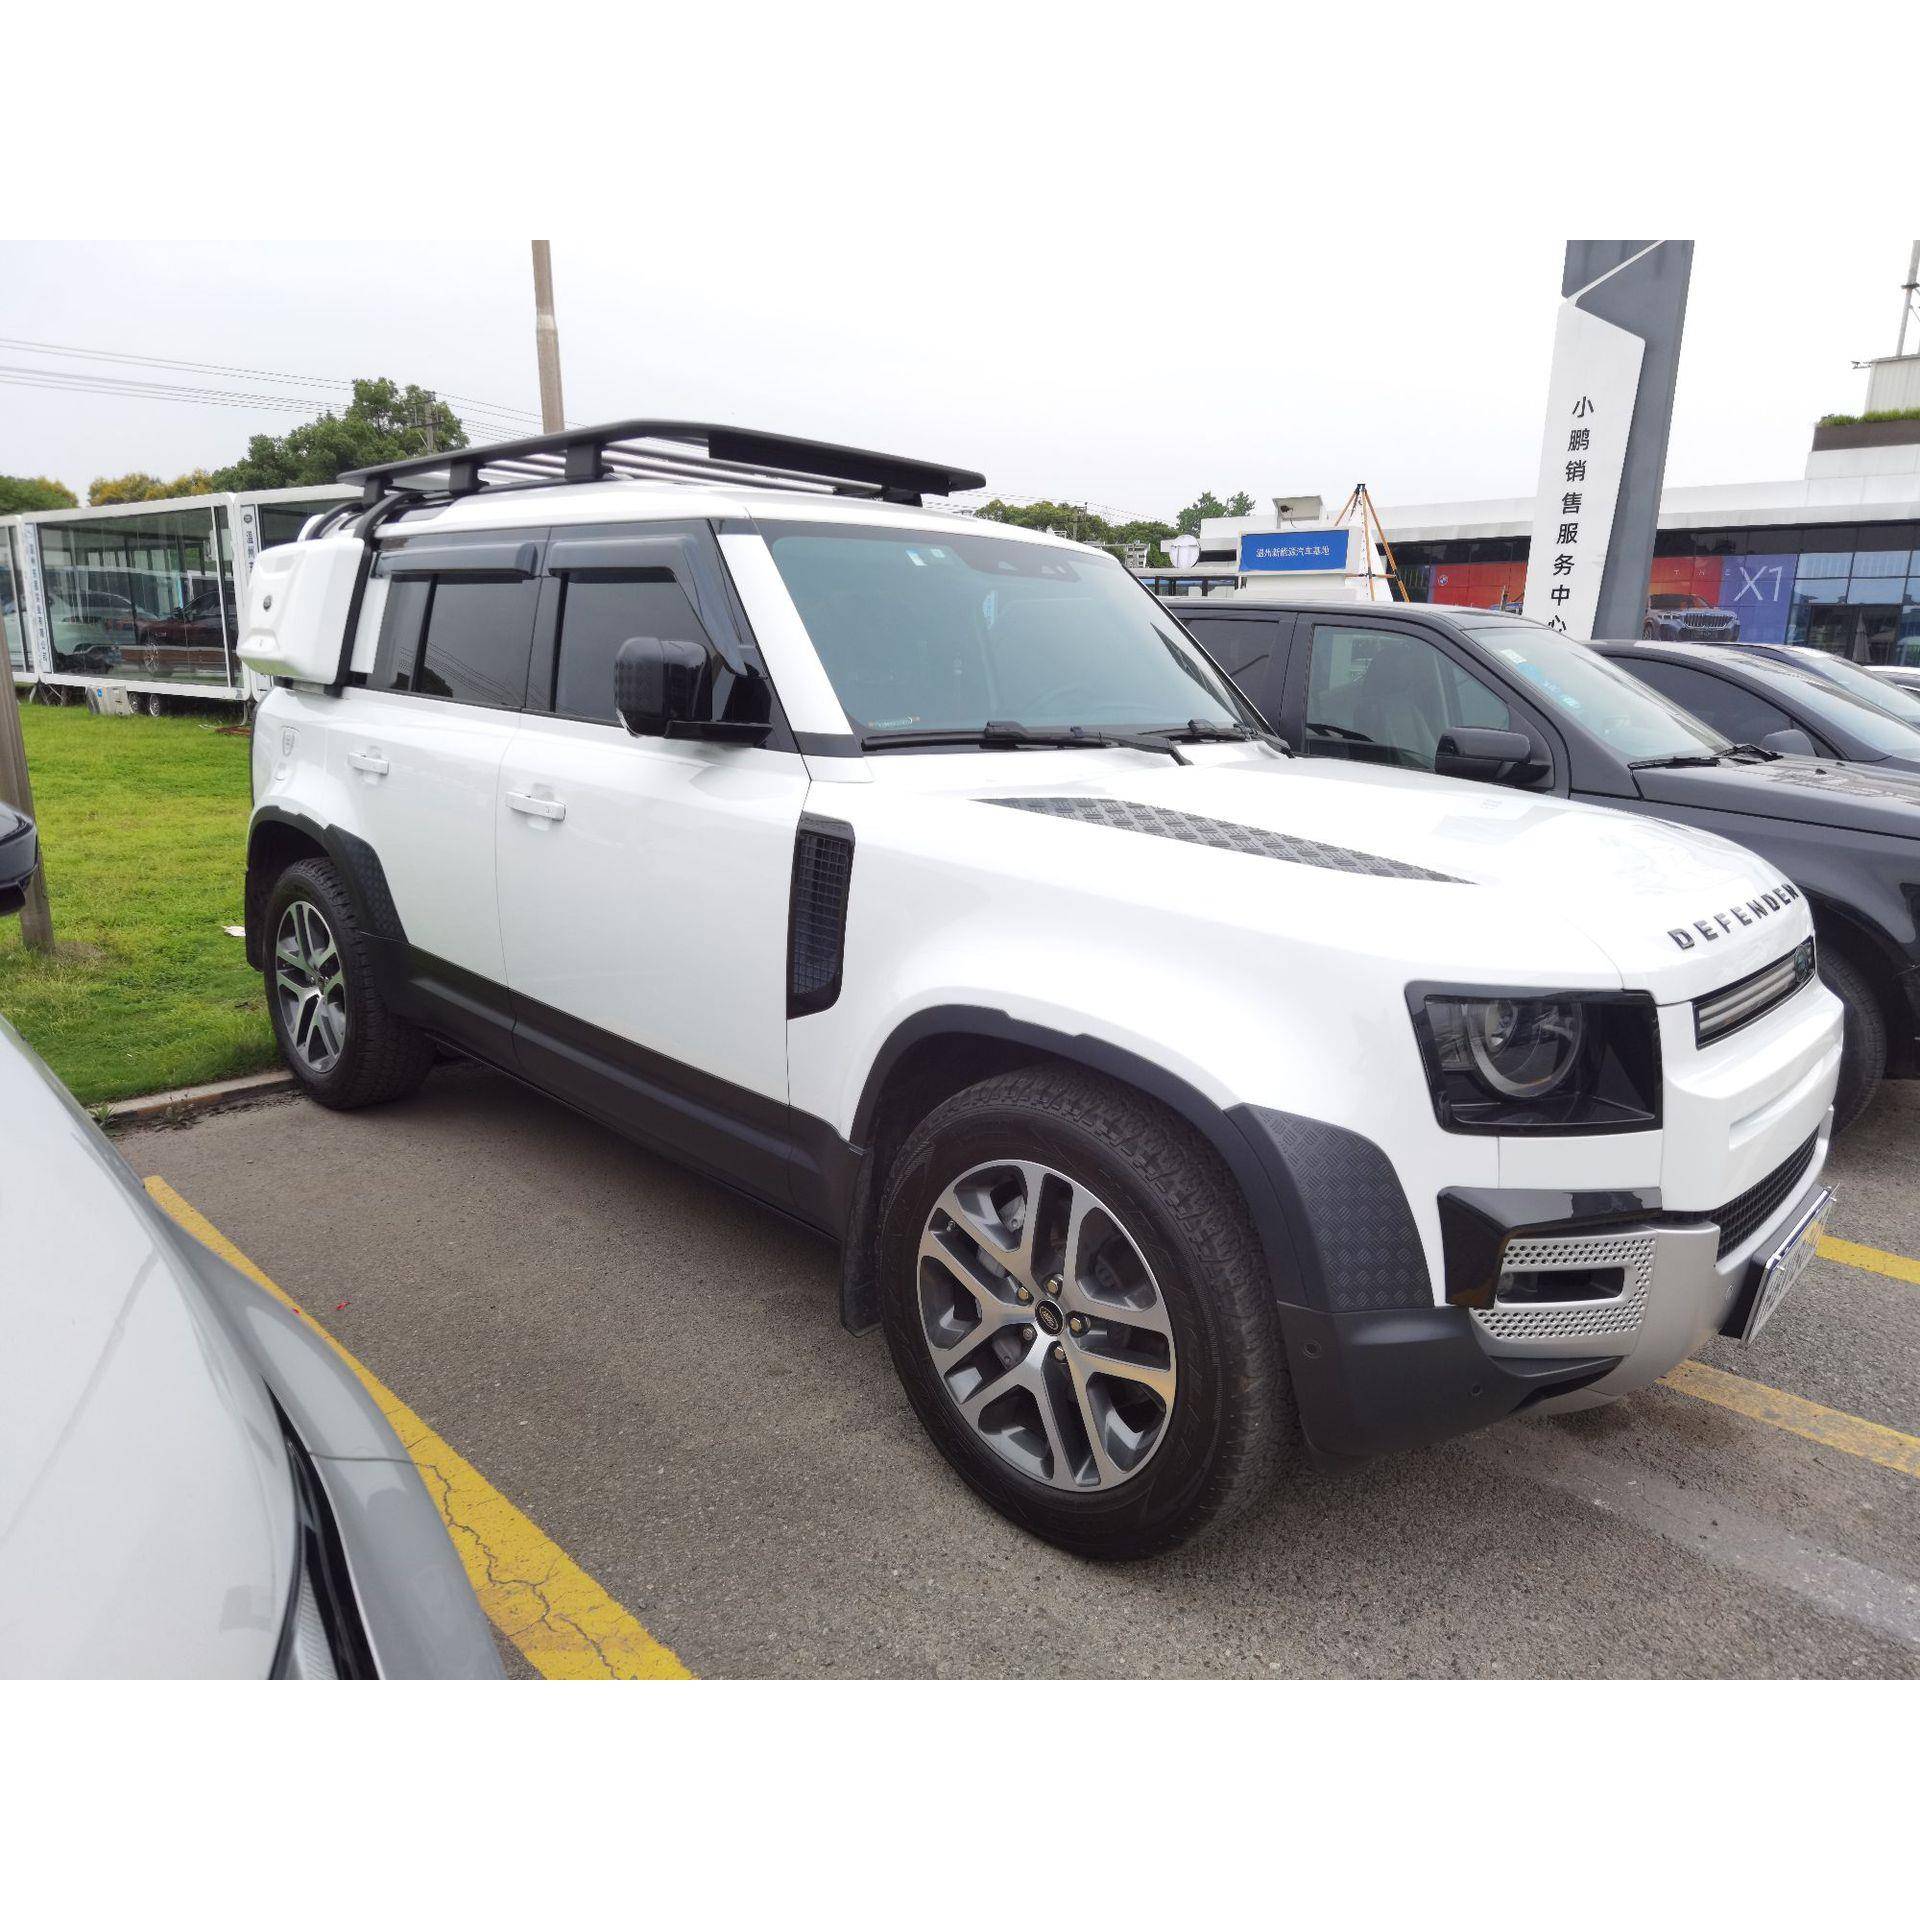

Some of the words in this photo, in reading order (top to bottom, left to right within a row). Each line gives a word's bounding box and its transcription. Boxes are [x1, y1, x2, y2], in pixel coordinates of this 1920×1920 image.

[1548, 396, 1594, 632] 小鹏销售服务中心
[1733, 566, 1783, 602] X1
[1667, 883, 1799, 950] DEFENDER
